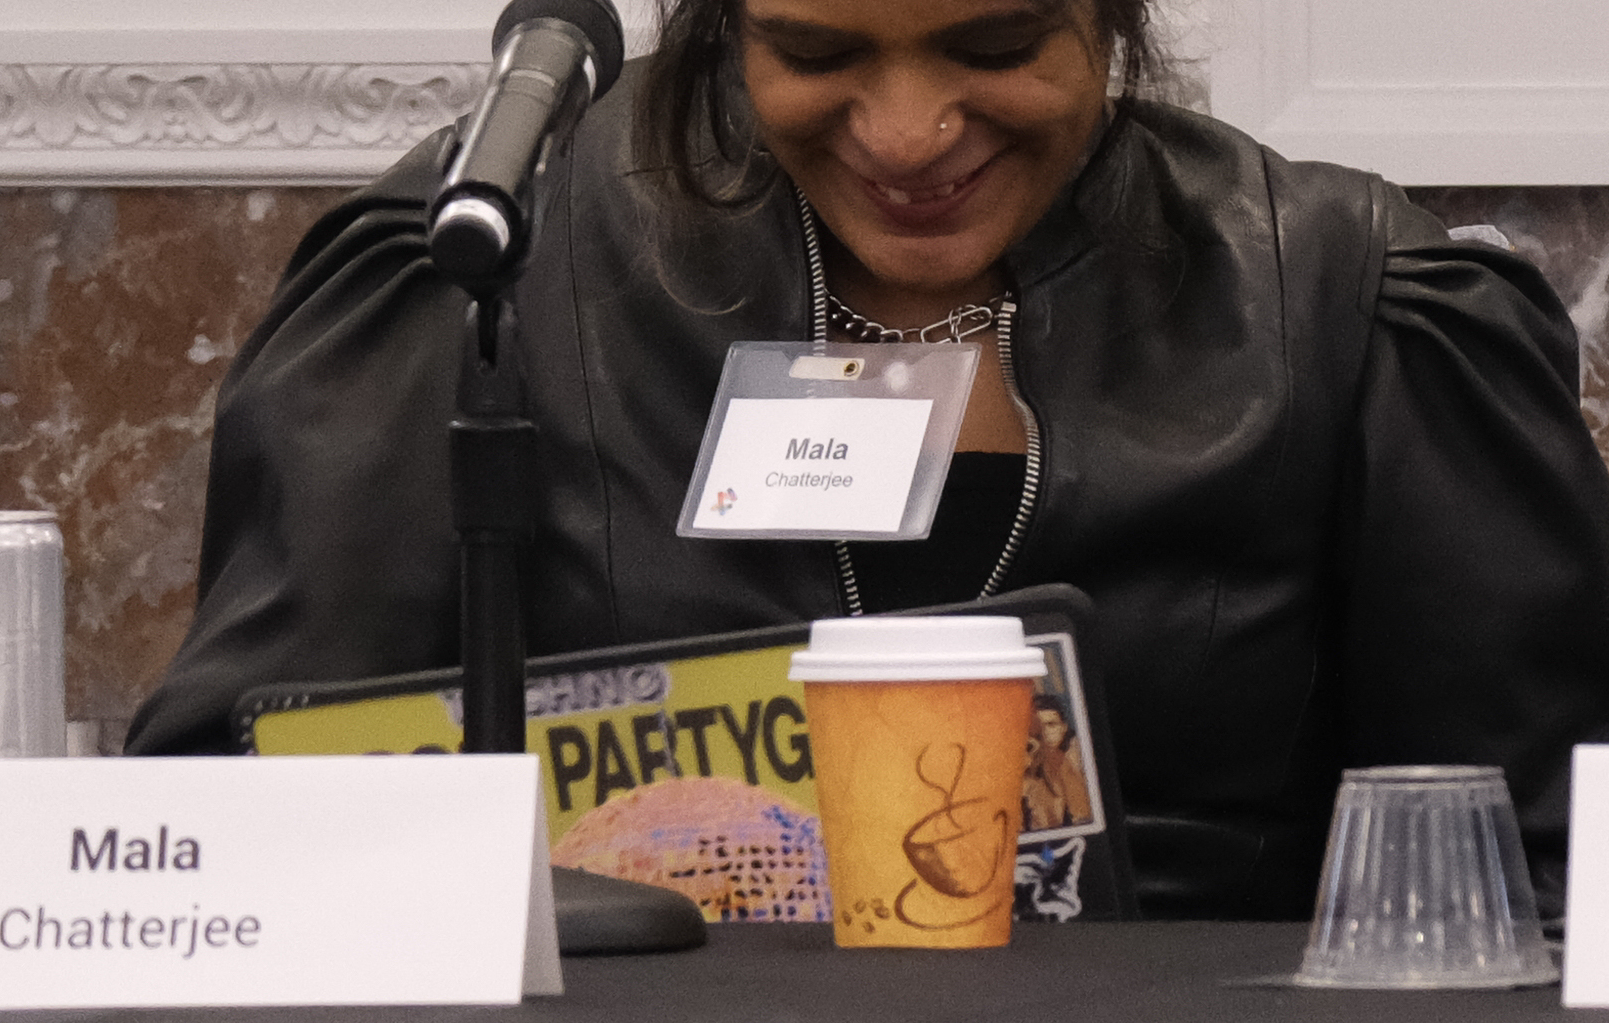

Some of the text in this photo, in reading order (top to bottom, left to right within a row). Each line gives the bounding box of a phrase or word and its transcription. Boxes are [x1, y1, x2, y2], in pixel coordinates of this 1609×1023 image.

[785, 437, 849, 461] Mala
[764, 471, 853, 491] Chatterjee
[69, 824, 201, 872] Mala
